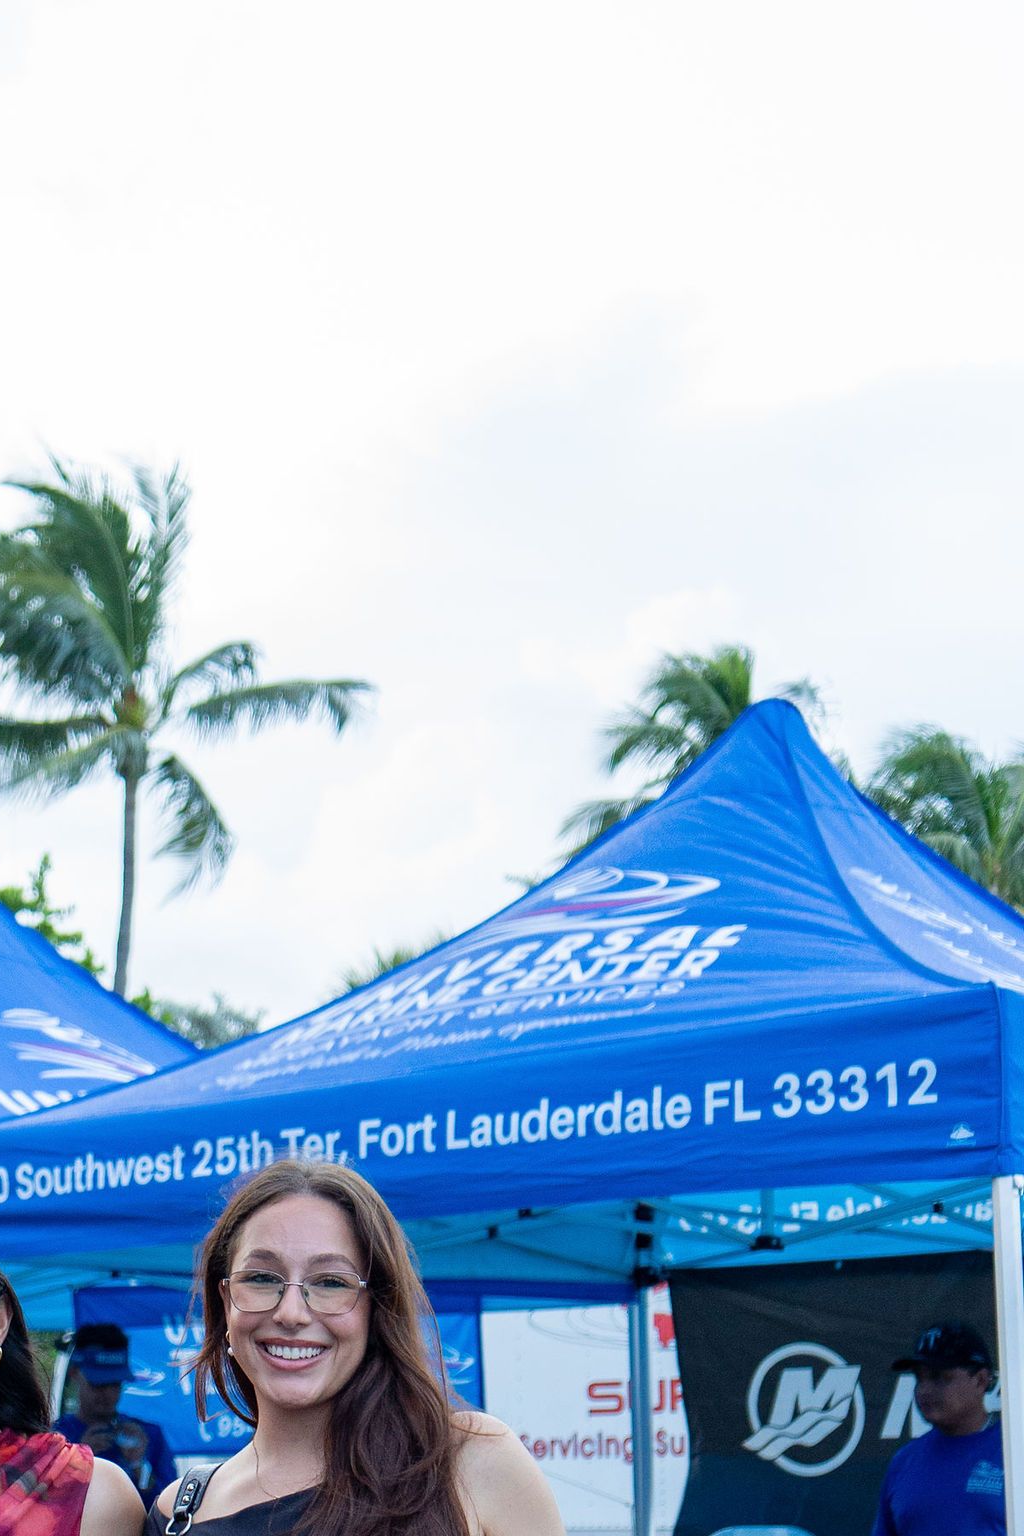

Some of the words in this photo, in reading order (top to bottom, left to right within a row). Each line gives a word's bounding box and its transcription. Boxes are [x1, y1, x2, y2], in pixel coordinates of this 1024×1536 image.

[481, 948, 721, 998] CENTER
[468, 980, 686, 1020] SERVICES
[14, 1145, 185, 1200] Southwest
[190, 1130, 274, 1179] 25th
[279, 1126, 348, 1165] Ter,
[358, 1112, 438, 1159] Fort
[445, 1085, 692, 1152] Lauderdale
[703, 1079, 762, 1125] FL
[772, 1057, 939, 1119] 33312
